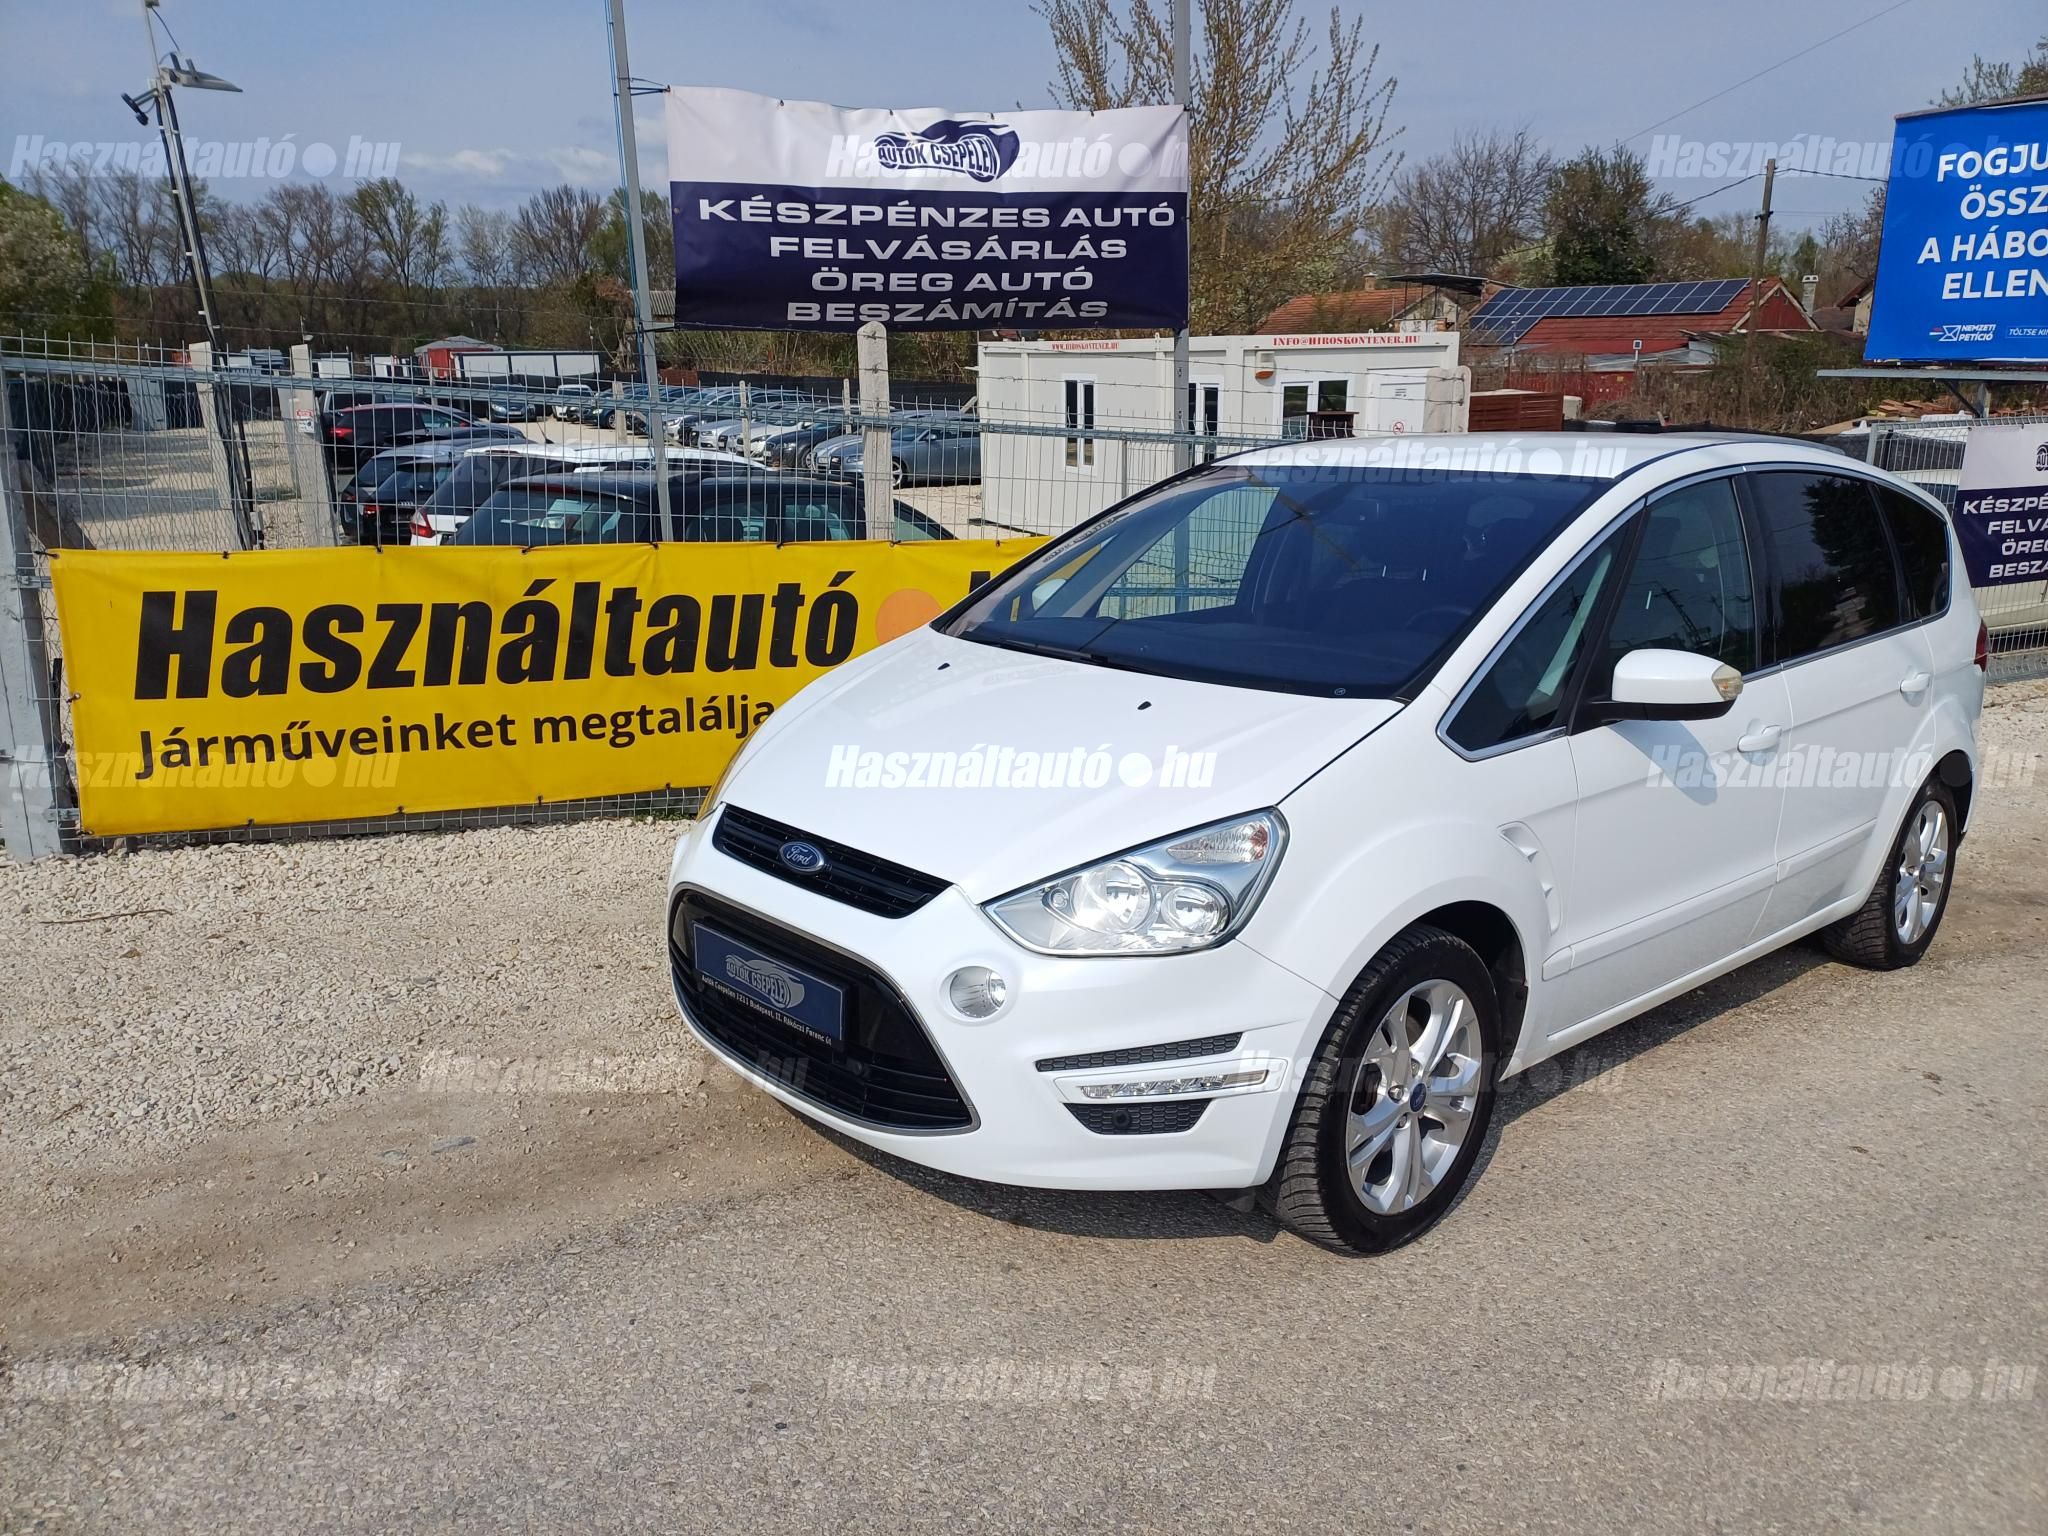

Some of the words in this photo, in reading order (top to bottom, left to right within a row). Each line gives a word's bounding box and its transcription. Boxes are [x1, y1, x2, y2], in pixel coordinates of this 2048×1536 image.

[700, 195, 1050, 227] KÉSZPÉNZES
[1060, 202, 1175, 227] AUTÓ
[1960, 184, 2048, 219] ÖSSZ
[771, 234, 1127, 260] FELVÁSÁRLÁS
[1917, 237, 1941, 264] A
[811, 267, 953, 291] ÖREG
[964, 266, 1093, 291] AUTÓ
[787, 297, 1108, 321] BESZÁMÍTÁS
[1273, 335, 1421, 346] INFO@HIROSKONTENER.HU
[1958, 332, 1993, 341] PETÍCIÓ
[1961, 324, 1996, 332] NEMZETI
[134, 571, 858, 700] Használtautó
[135, 713, 516, 780] Járműveinket
[533, 694, 775, 748] megtalálja
[786, 845, 814, 866] Ford
